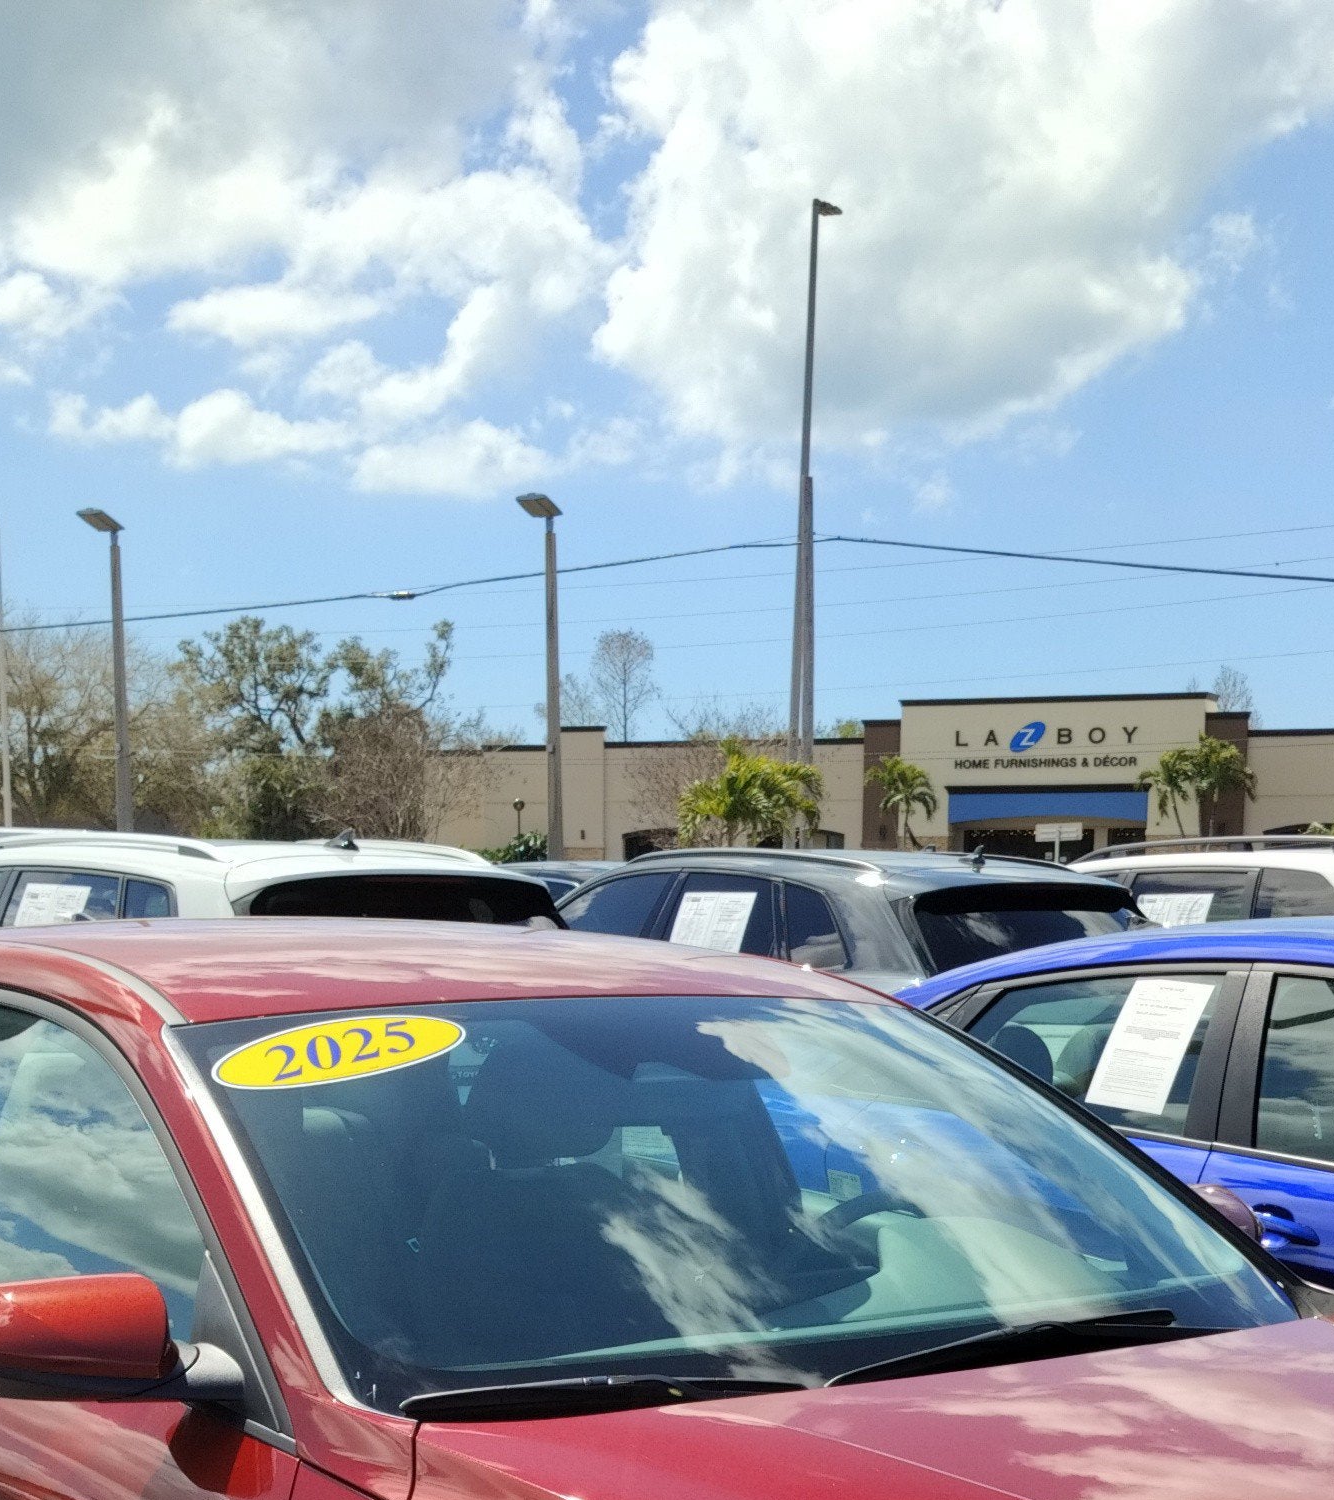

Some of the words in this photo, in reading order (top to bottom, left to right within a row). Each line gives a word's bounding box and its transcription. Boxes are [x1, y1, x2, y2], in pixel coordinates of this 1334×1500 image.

[954, 758, 990, 770] HOME
[993, 757, 1077, 769] FURNISHINGS
[1081, 757, 1089, 768] &
[1093, 754, 1138, 767] DÉCOR
[264, 1020, 416, 1082] 2025
